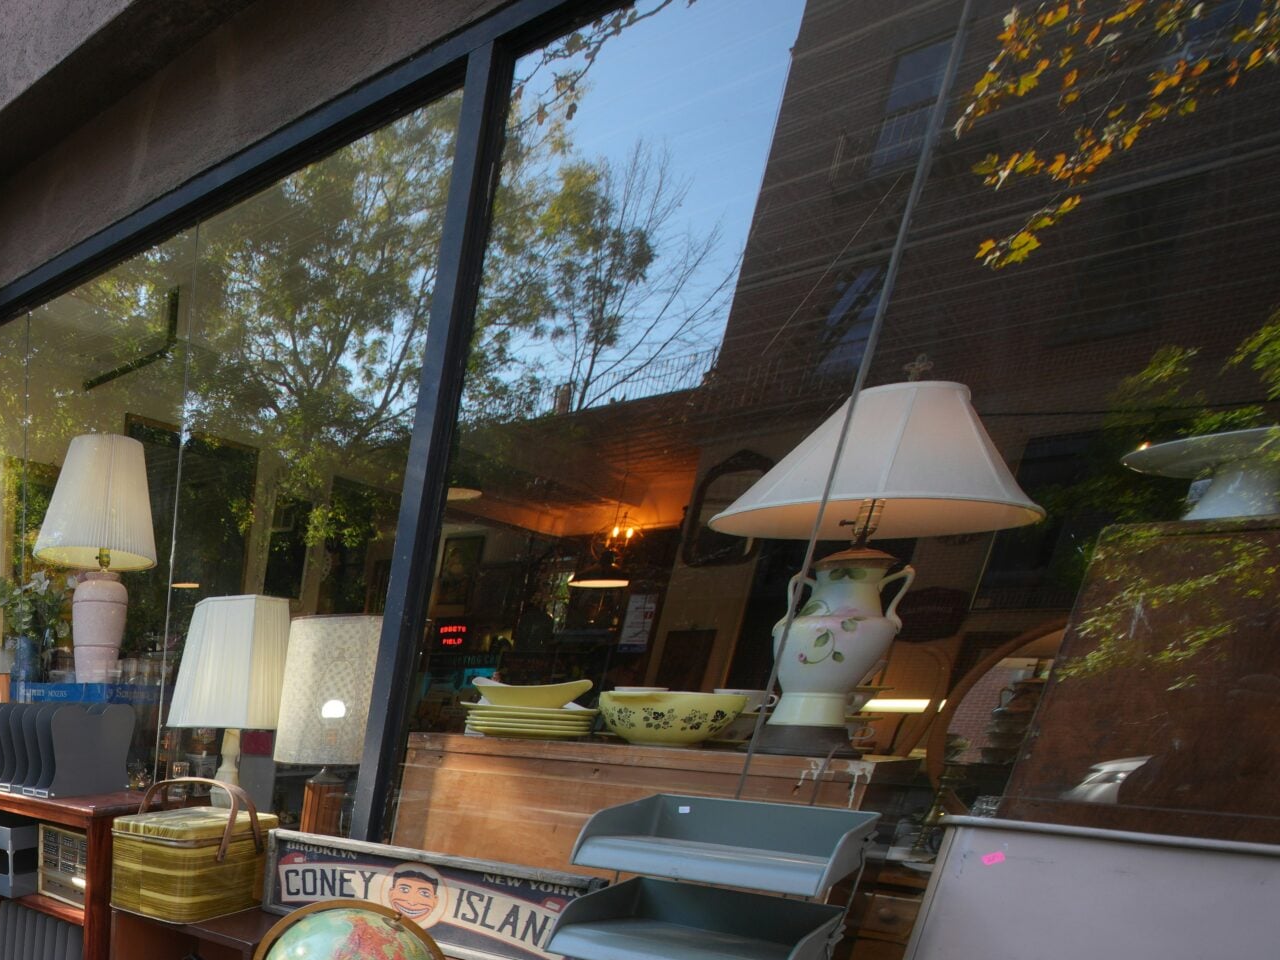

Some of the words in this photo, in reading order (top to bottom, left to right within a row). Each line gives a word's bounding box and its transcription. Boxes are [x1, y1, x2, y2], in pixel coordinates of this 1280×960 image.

[285, 841, 358, 861] BROOKLYN
[482, 872, 522, 889] NEW
[528, 879, 584, 898] YORK
[285, 868, 379, 901] CONEY
[452, 887, 557, 950] ISLAN
